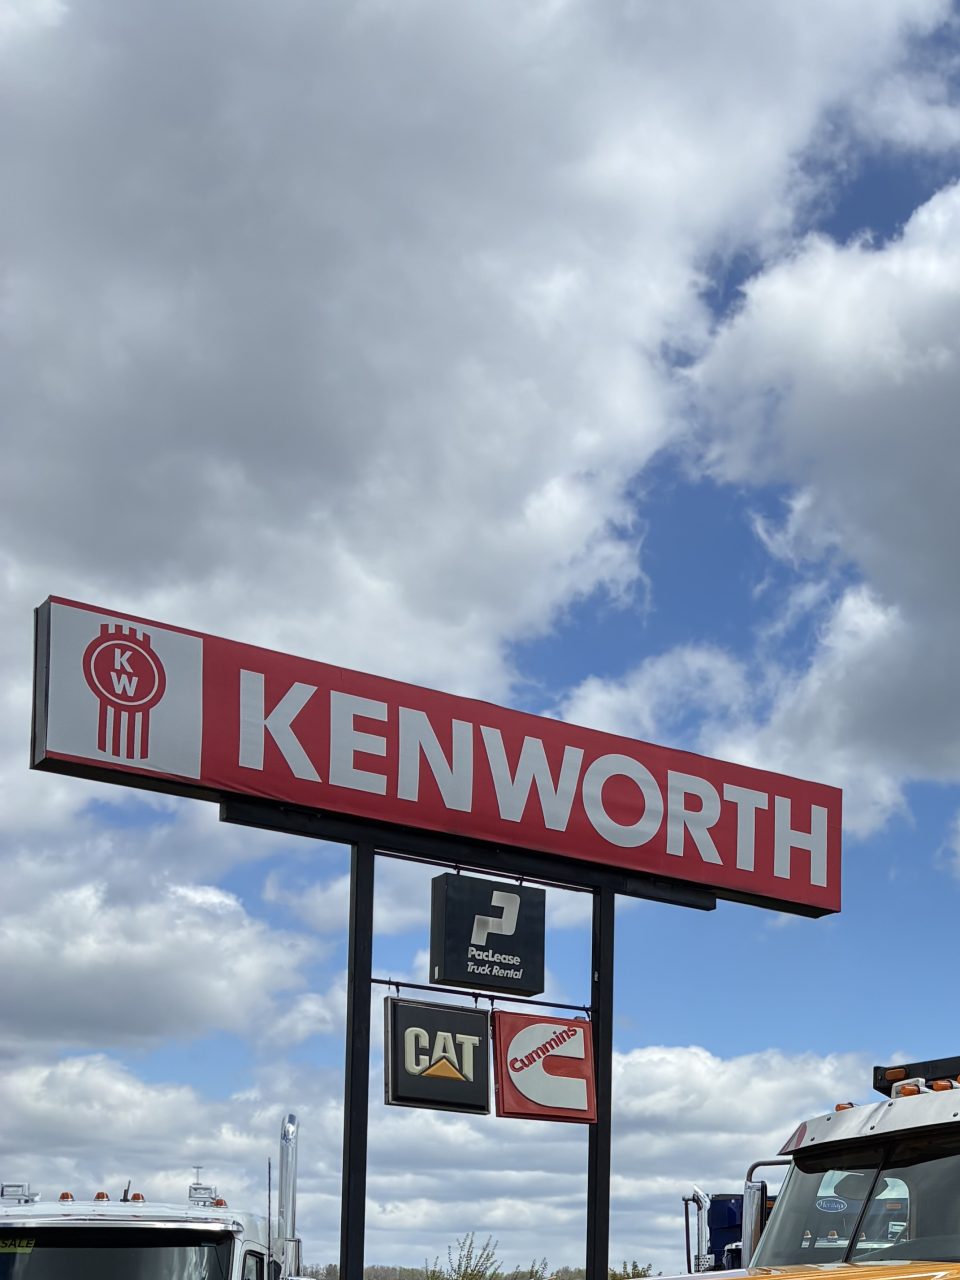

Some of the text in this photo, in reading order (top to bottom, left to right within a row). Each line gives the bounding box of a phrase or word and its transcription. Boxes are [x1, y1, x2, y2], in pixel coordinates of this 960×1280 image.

[238, 668, 829, 888] KENWORTH
[466, 961, 523, 980] Truck Rental
[468, 947, 521, 965] PacLease
[404, 1027, 481, 1082] CAT
[509, 1026, 578, 1073] Cummins
[0, 1239, 36, 1249] SALE
